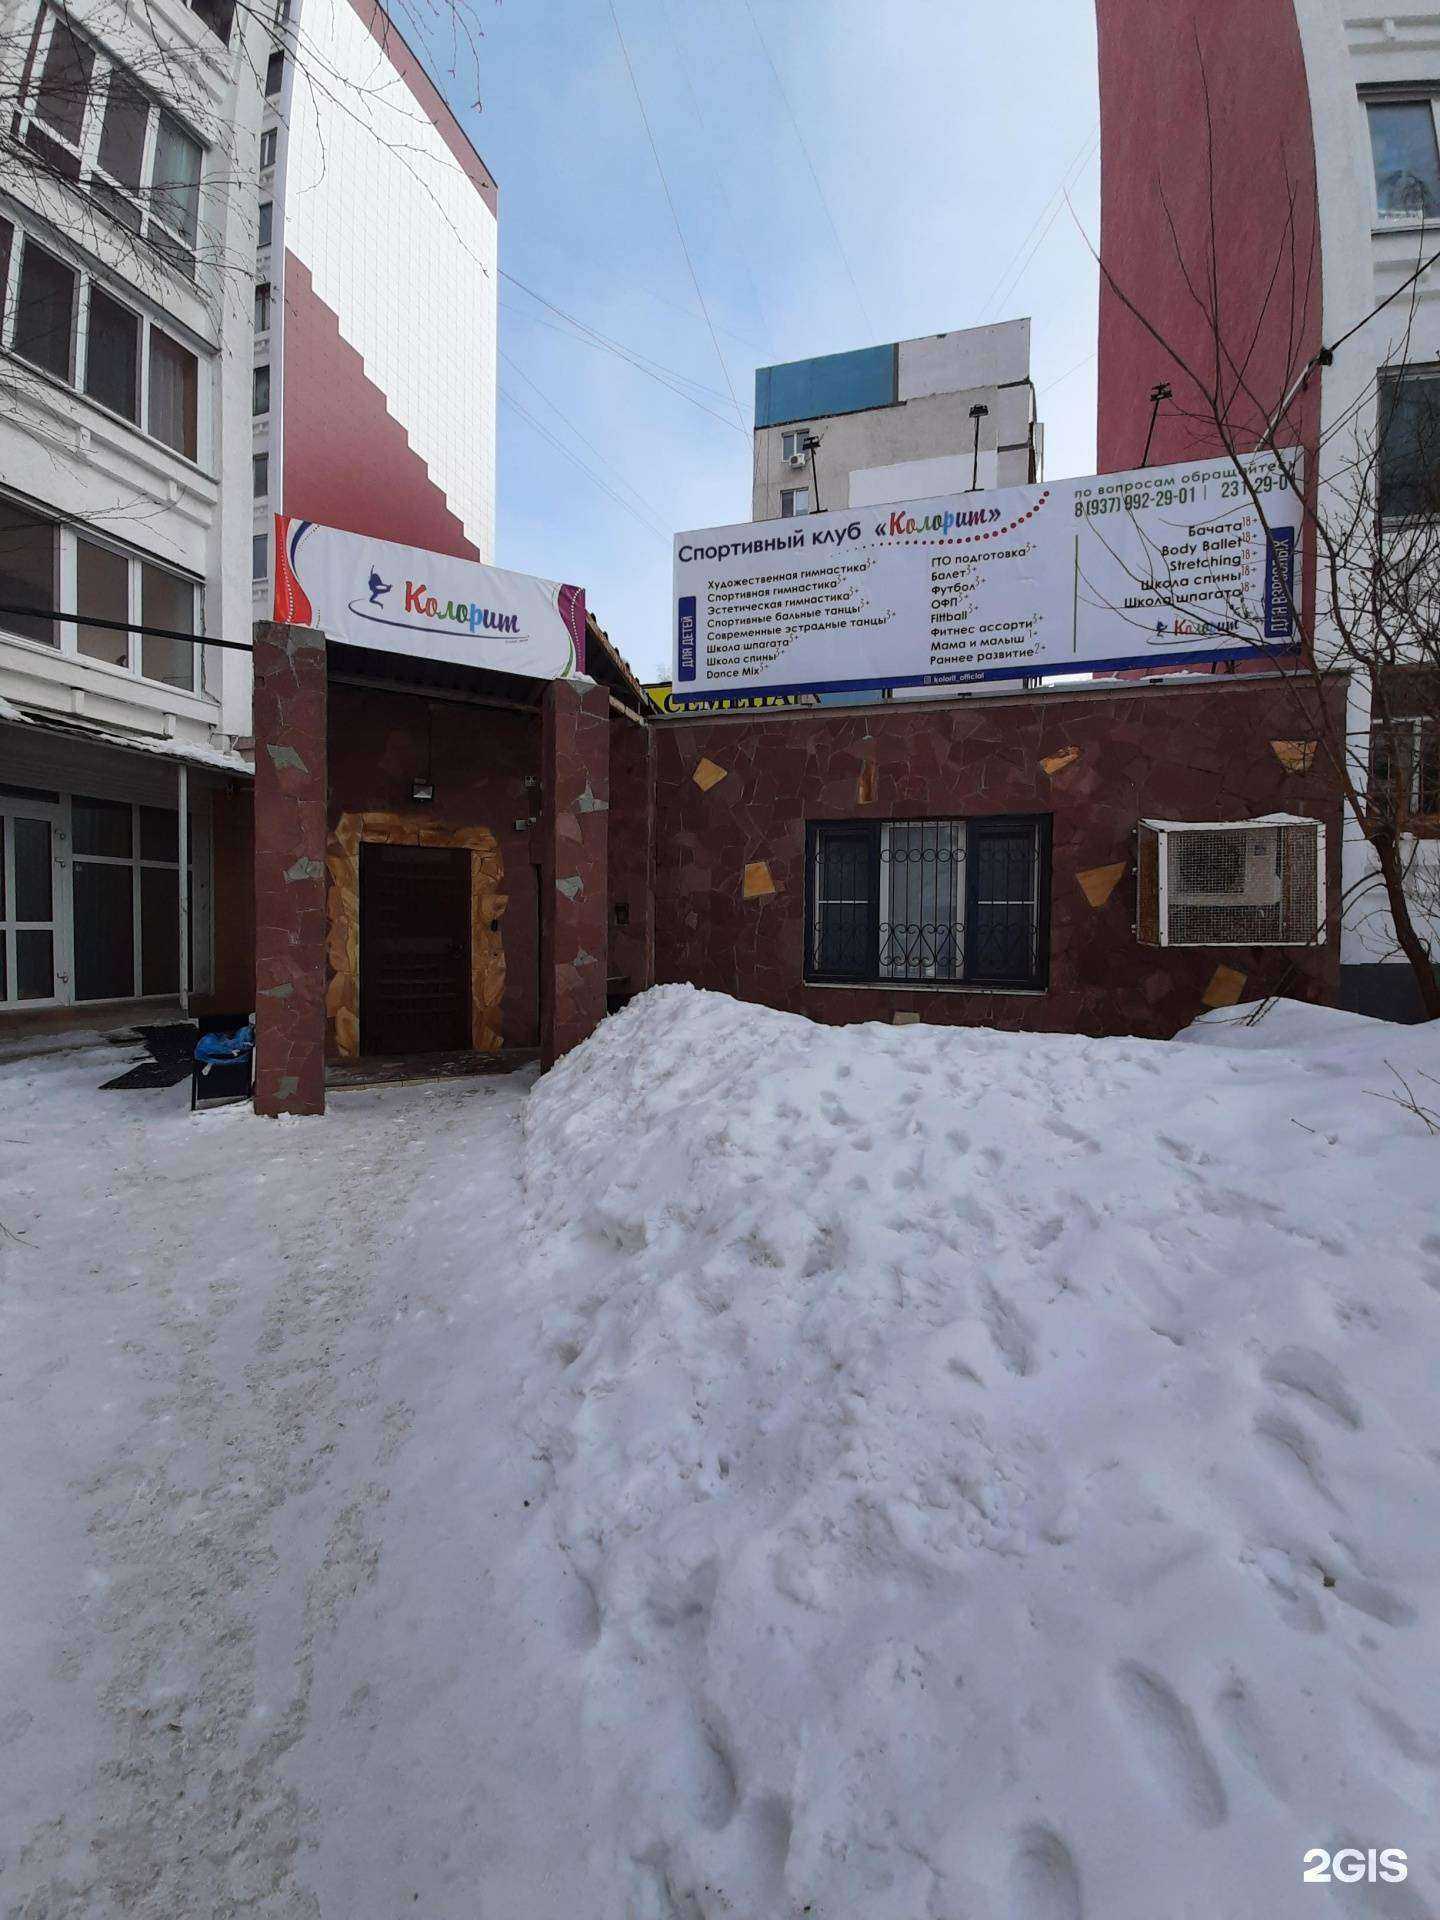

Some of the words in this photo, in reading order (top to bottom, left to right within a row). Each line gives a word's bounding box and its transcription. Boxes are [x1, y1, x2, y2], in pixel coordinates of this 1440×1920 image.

[1074, 489, 1092, 499] по
[1097, 478, 1175, 495] вопросам
[678, 528, 805, 562] Спортивный
[812, 521, 862, 546] клуб
[874, 507, 1002, 537] «Колорит»
[1162, 543, 1197, 556] Body
[931, 556, 951, 567] ГТО
[707, 571, 798, 590] Художественная
[707, 588, 770, 604] Спортивная
[1124, 596, 1172, 609] Школа
[404, 580, 521, 634] Колорит
[707, 601, 782, 616] Эстетическая
[707, 615, 772, 629] Спортивные
[775, 609, 822, 621] бальные
[707, 627, 782, 642] Современные
[785, 620, 847, 634] эстрадные
[930, 626, 975, 637] Фитнес
[706, 642, 740, 654] Школа
[930, 640, 966, 651] Мама
[969, 639, 977, 647] и
[980, 636, 1025, 646] малыш
[706, 656, 740, 667] Школа
[930, 654, 973, 665] Раннее
[706, 669, 739, 679] Dance
